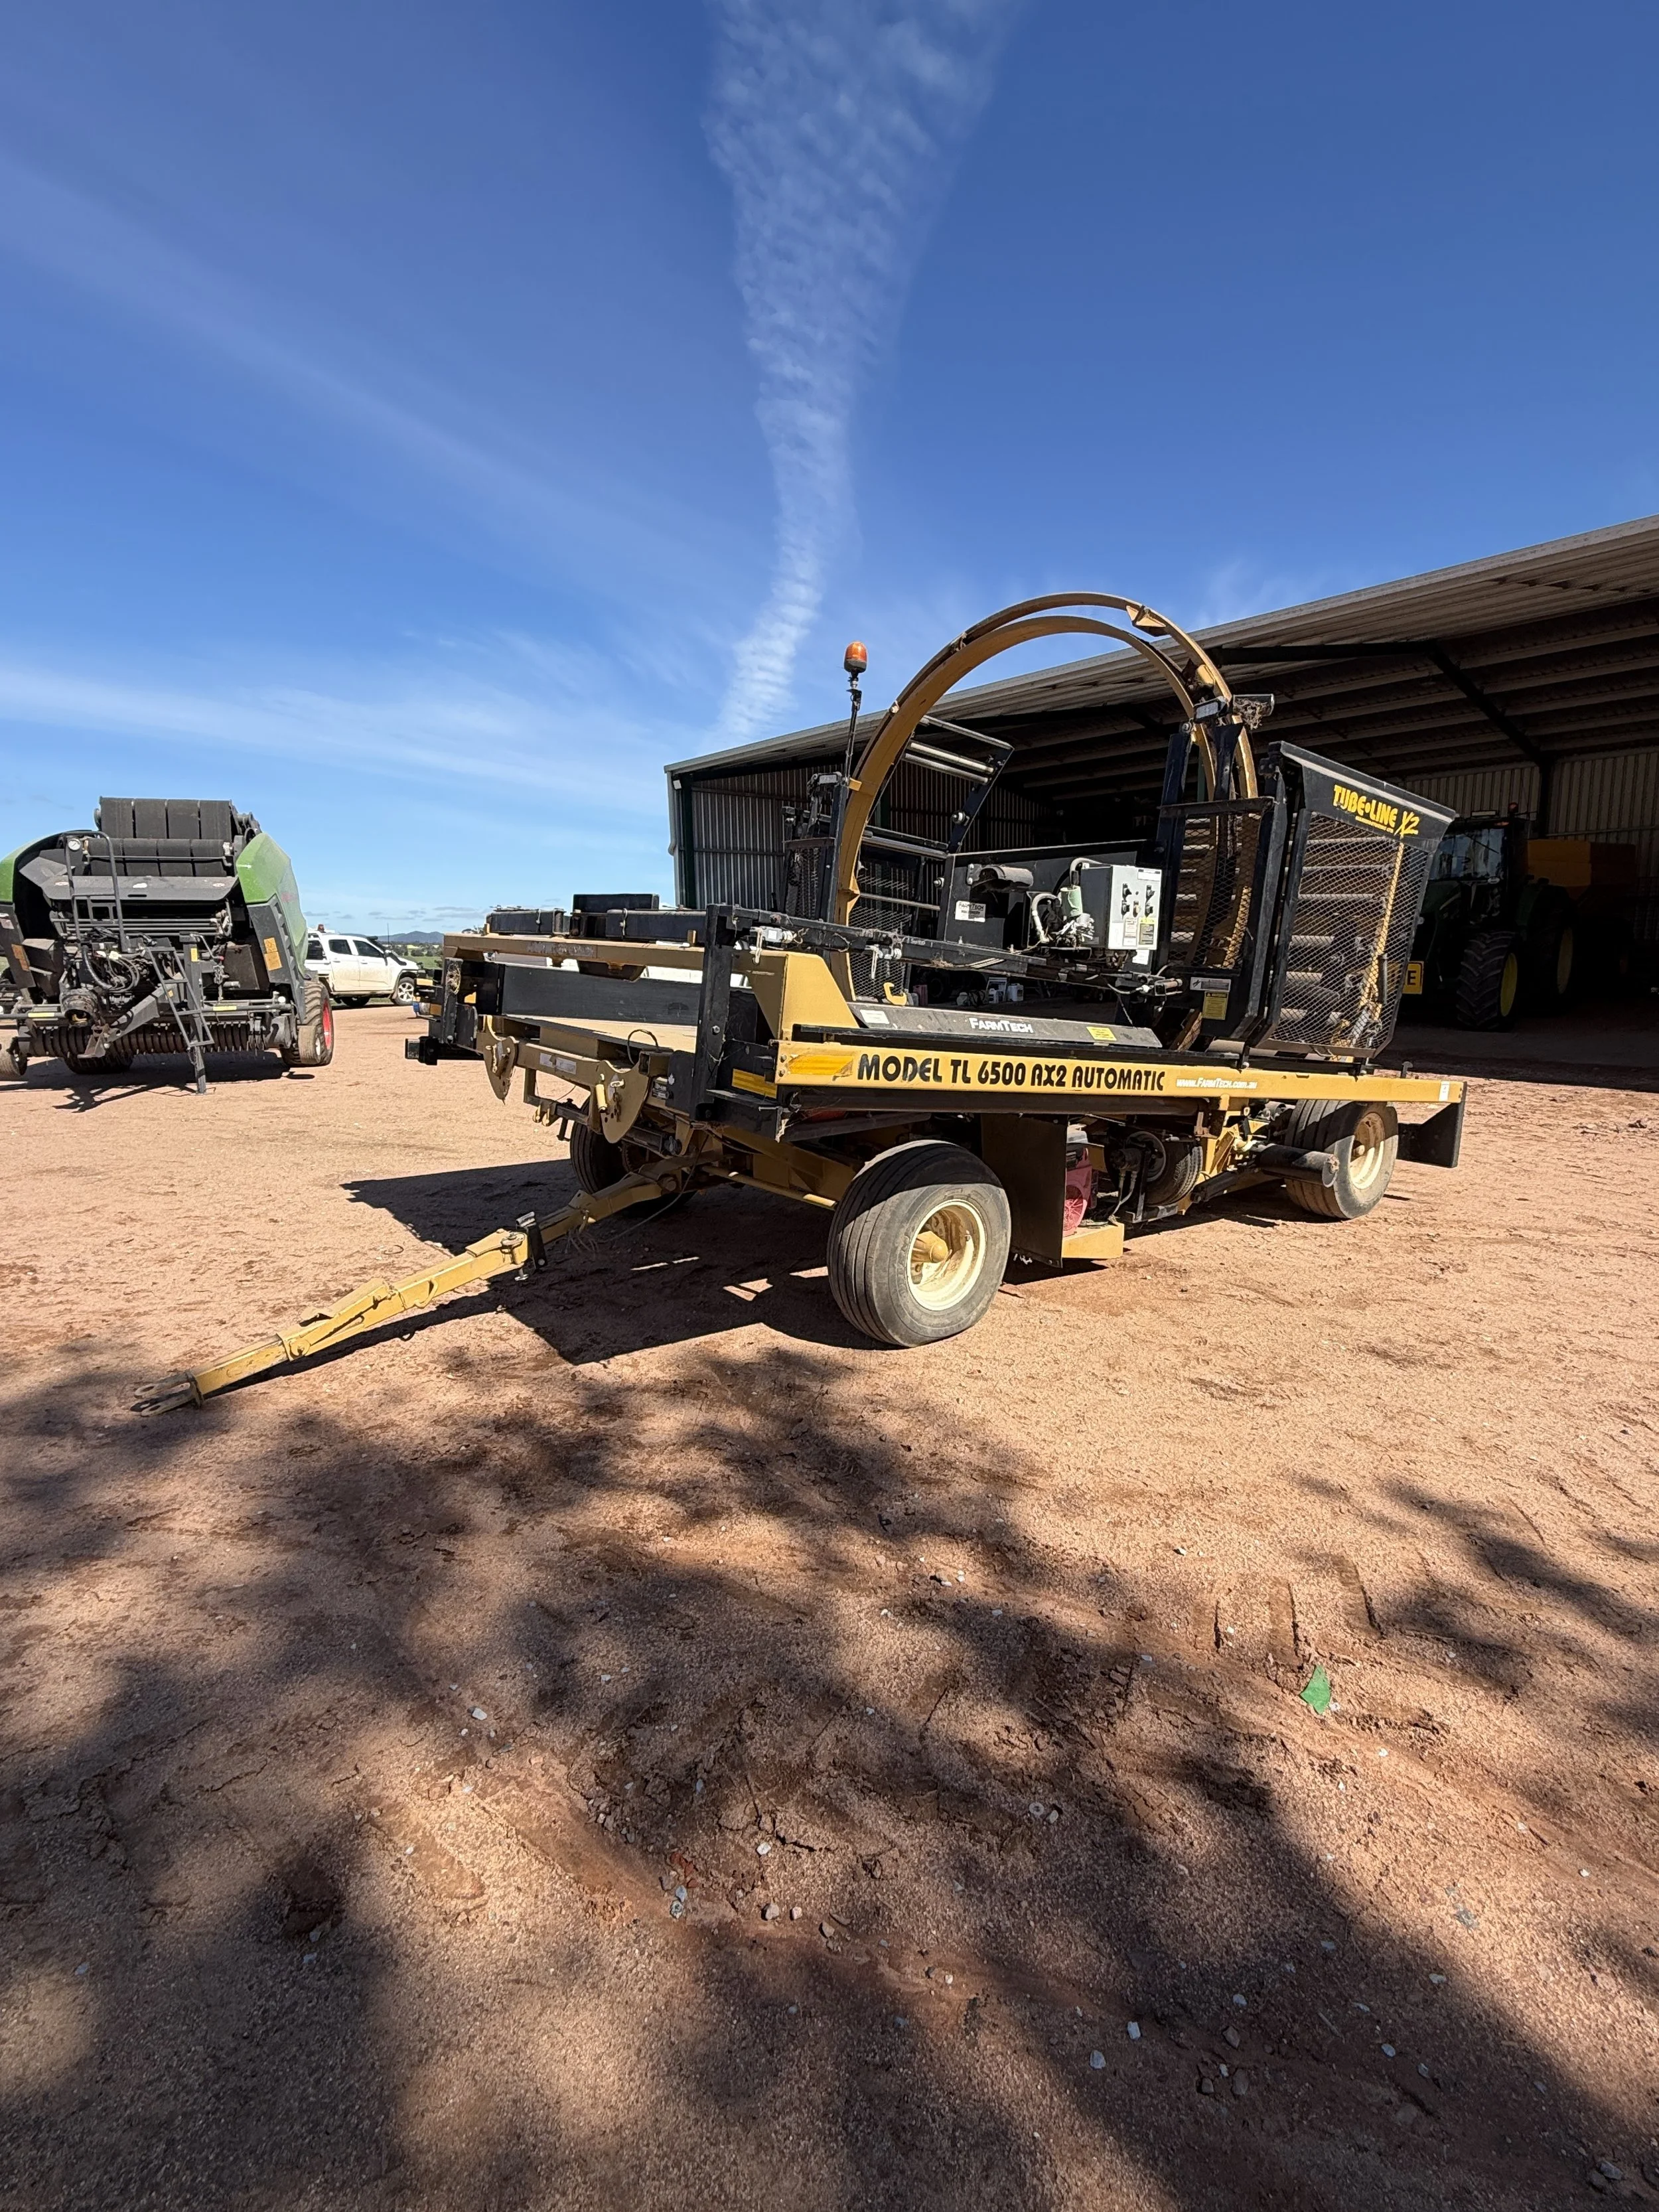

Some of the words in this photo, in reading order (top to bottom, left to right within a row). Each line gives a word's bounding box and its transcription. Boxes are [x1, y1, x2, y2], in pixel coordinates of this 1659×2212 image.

[857, 1053, 942, 1082] MODEL
[950, 1059, 971, 1084] TL
[977, 1061, 1026, 1086] 6500
[1071, 1065, 1165, 1091] AUTOMATIC
